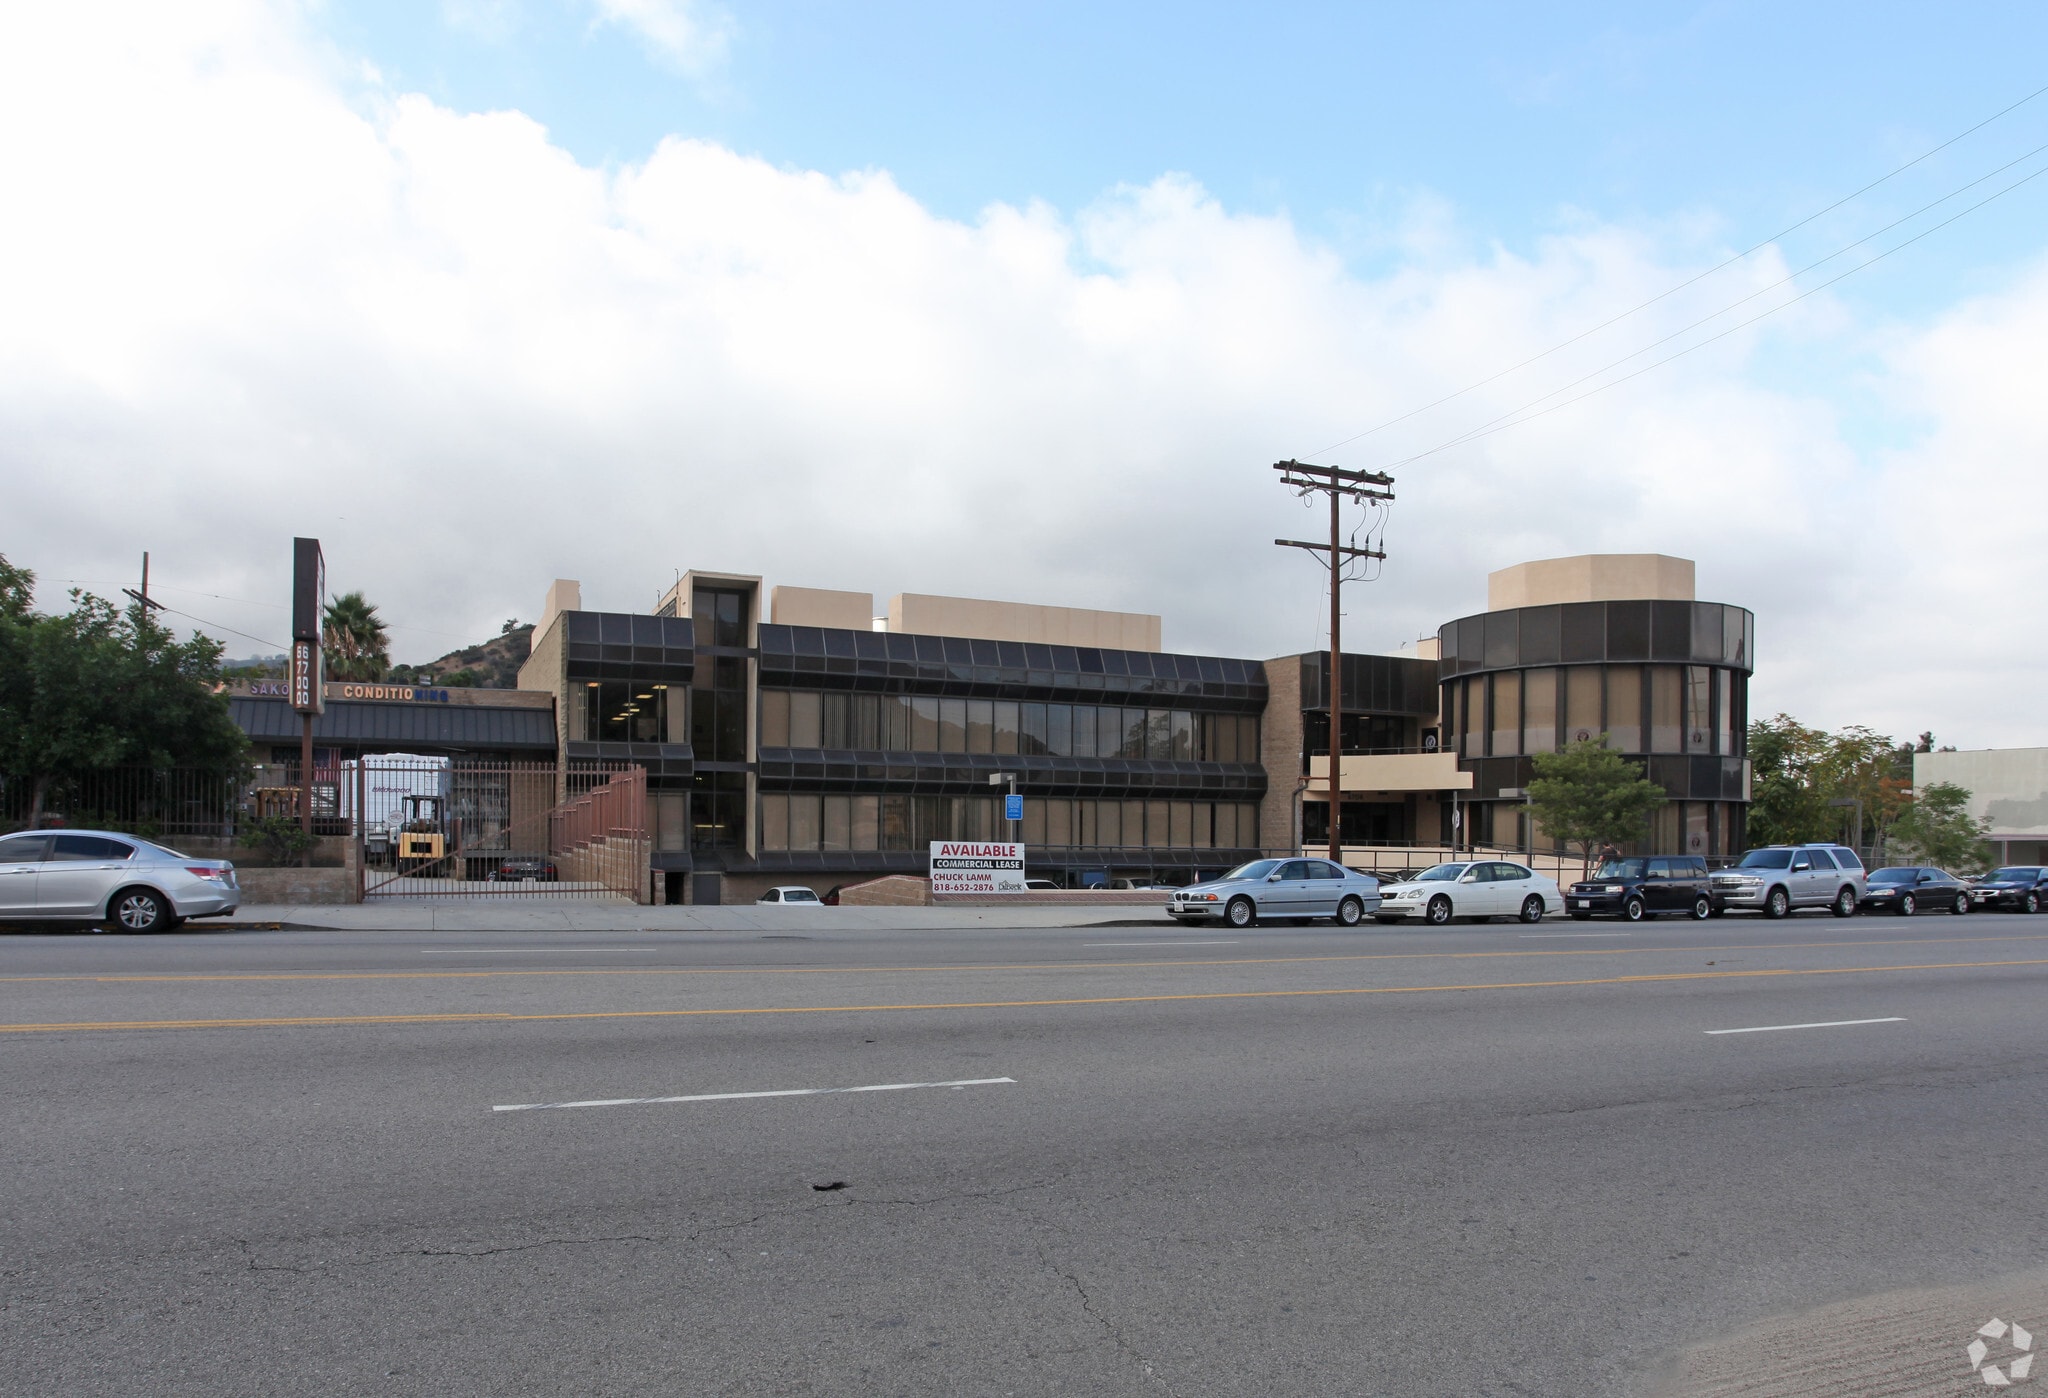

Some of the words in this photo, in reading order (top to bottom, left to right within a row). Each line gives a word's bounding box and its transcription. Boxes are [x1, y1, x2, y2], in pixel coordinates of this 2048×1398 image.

[343, 685, 449, 702] CONDITIONING
[940, 844, 1016, 856] AVAILABLE
[937, 859, 993, 868] COMMERCIAL
[995, 860, 1020, 869] LEASE
[933, 873, 964, 881] CHUCK
[966, 873, 992, 881] LAMM
[934, 883, 994, 891] 818-652-2876
